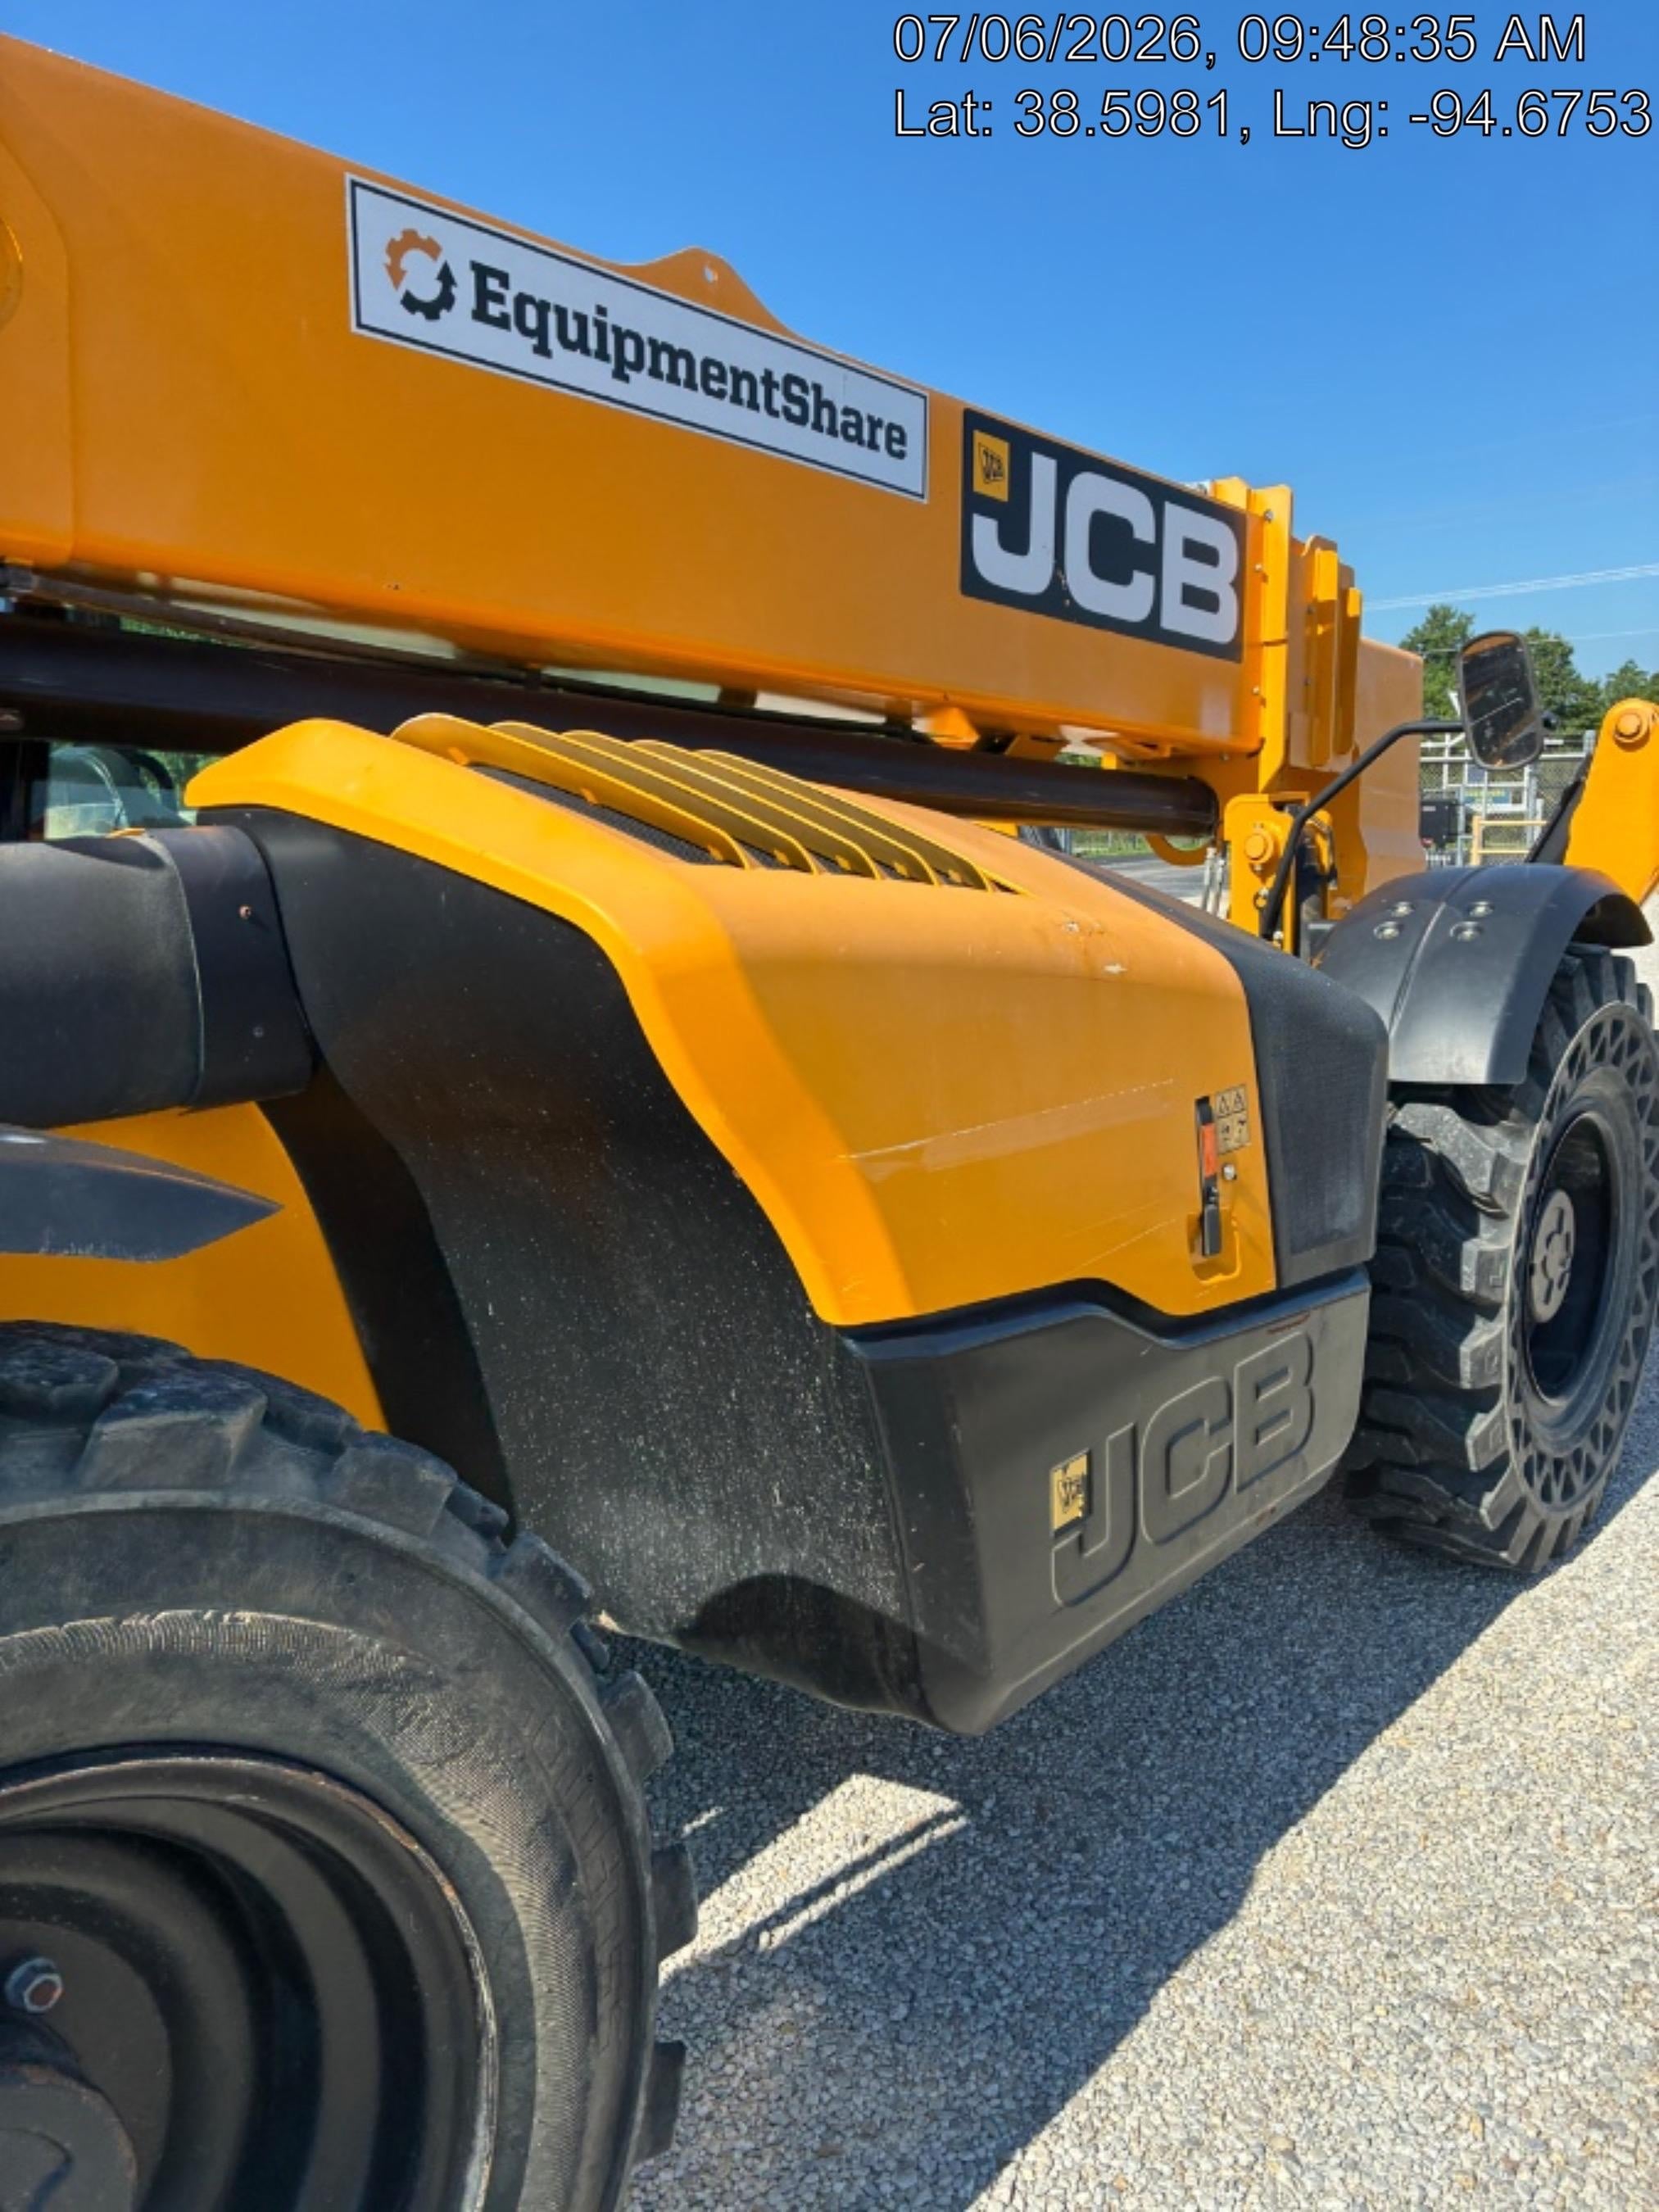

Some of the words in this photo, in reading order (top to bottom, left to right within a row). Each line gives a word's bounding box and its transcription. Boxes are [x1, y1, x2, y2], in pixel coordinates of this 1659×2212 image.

[469, 261, 908, 460] EquipmentShare
[972, 452, 1238, 643] JCB
[1052, 1330, 1315, 1607] JCB
